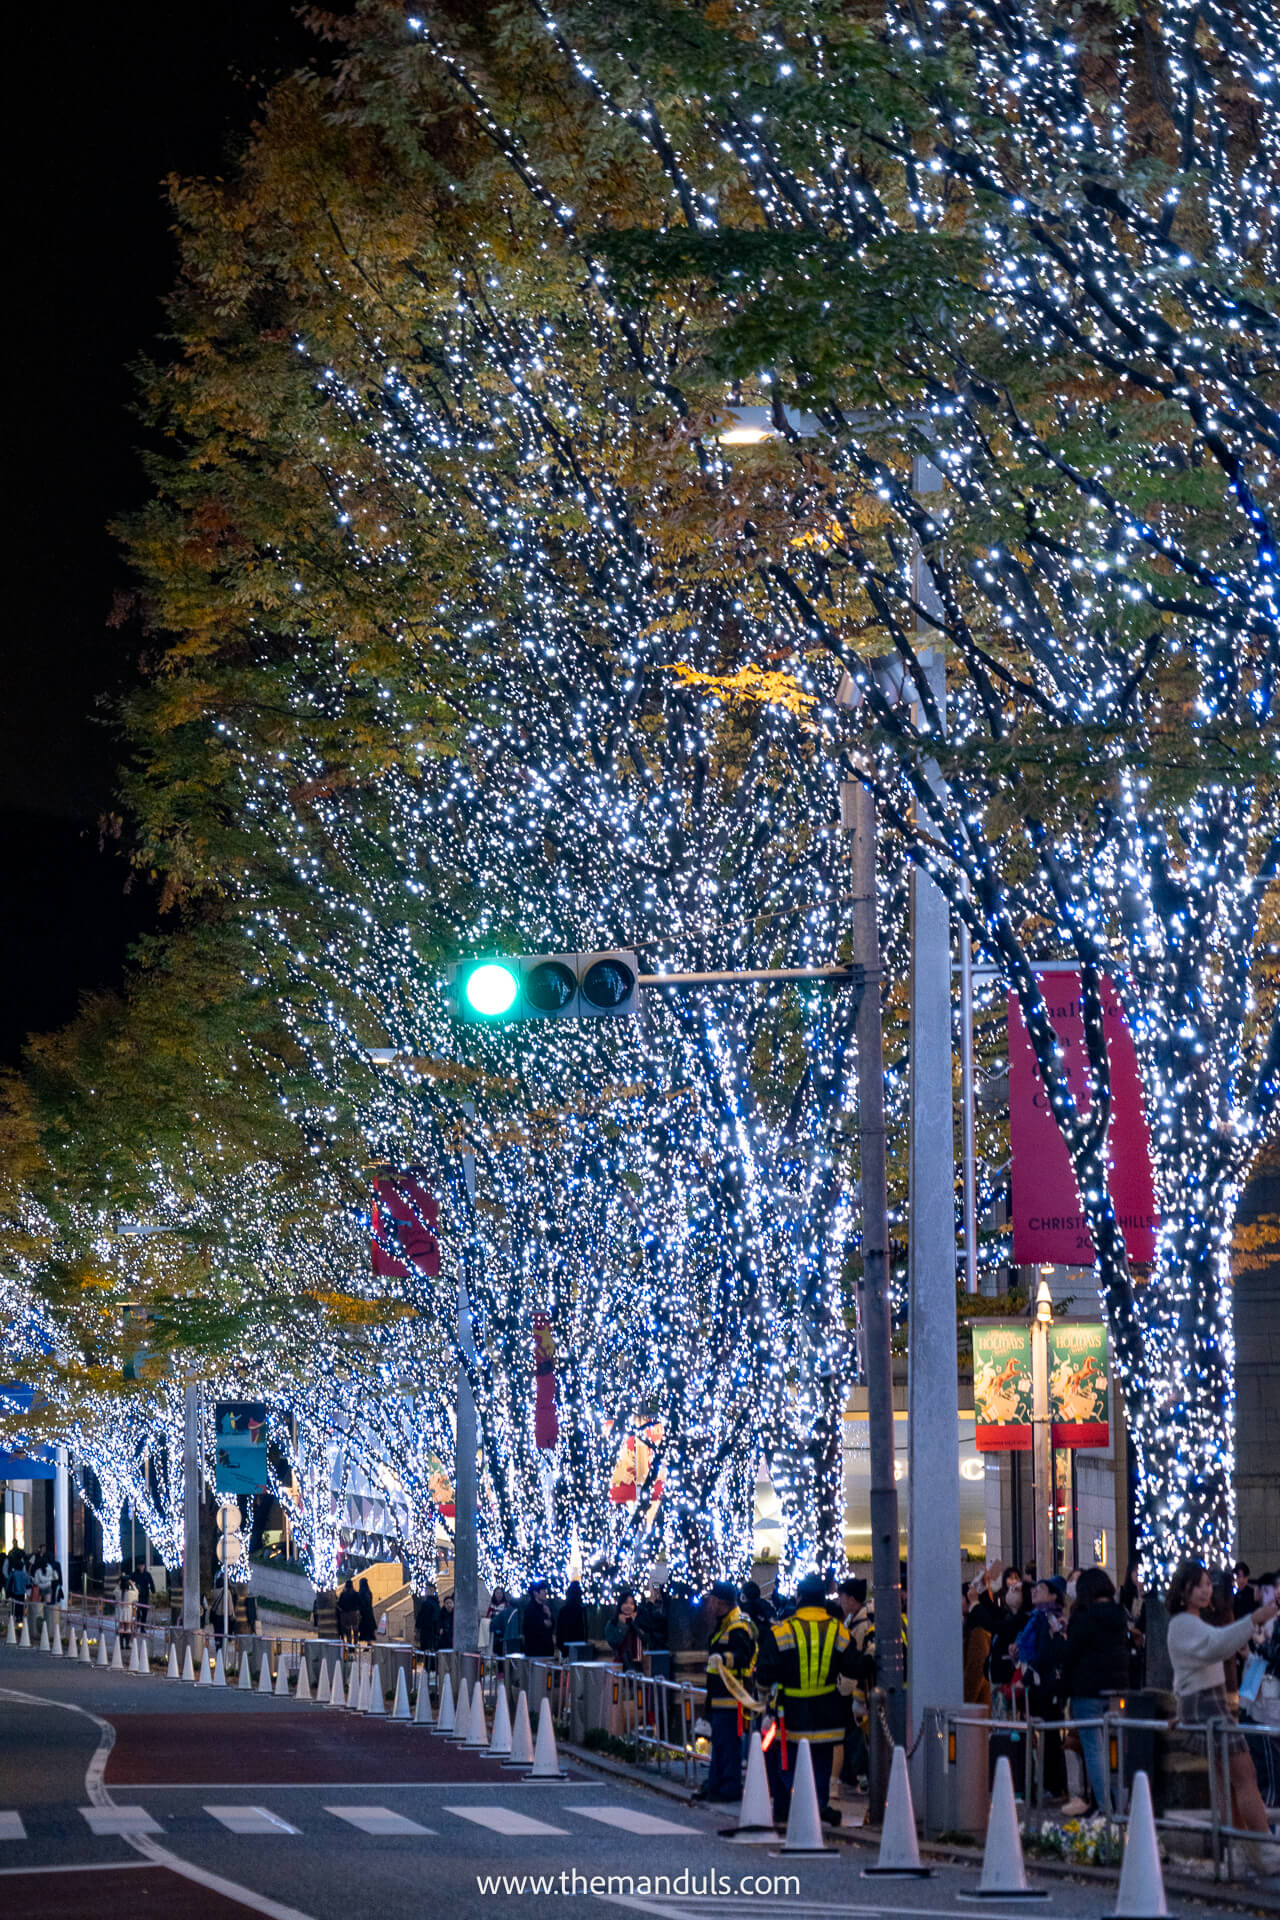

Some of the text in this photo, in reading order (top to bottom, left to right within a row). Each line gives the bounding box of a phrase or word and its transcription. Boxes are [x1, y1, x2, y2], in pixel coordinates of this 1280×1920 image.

[1028, 1215, 1153, 1231] CHRIST HILLS
[980, 1337, 1025, 1350] HOLIDAYS
[1056, 1335, 1102, 1349] HOLIDAYS
